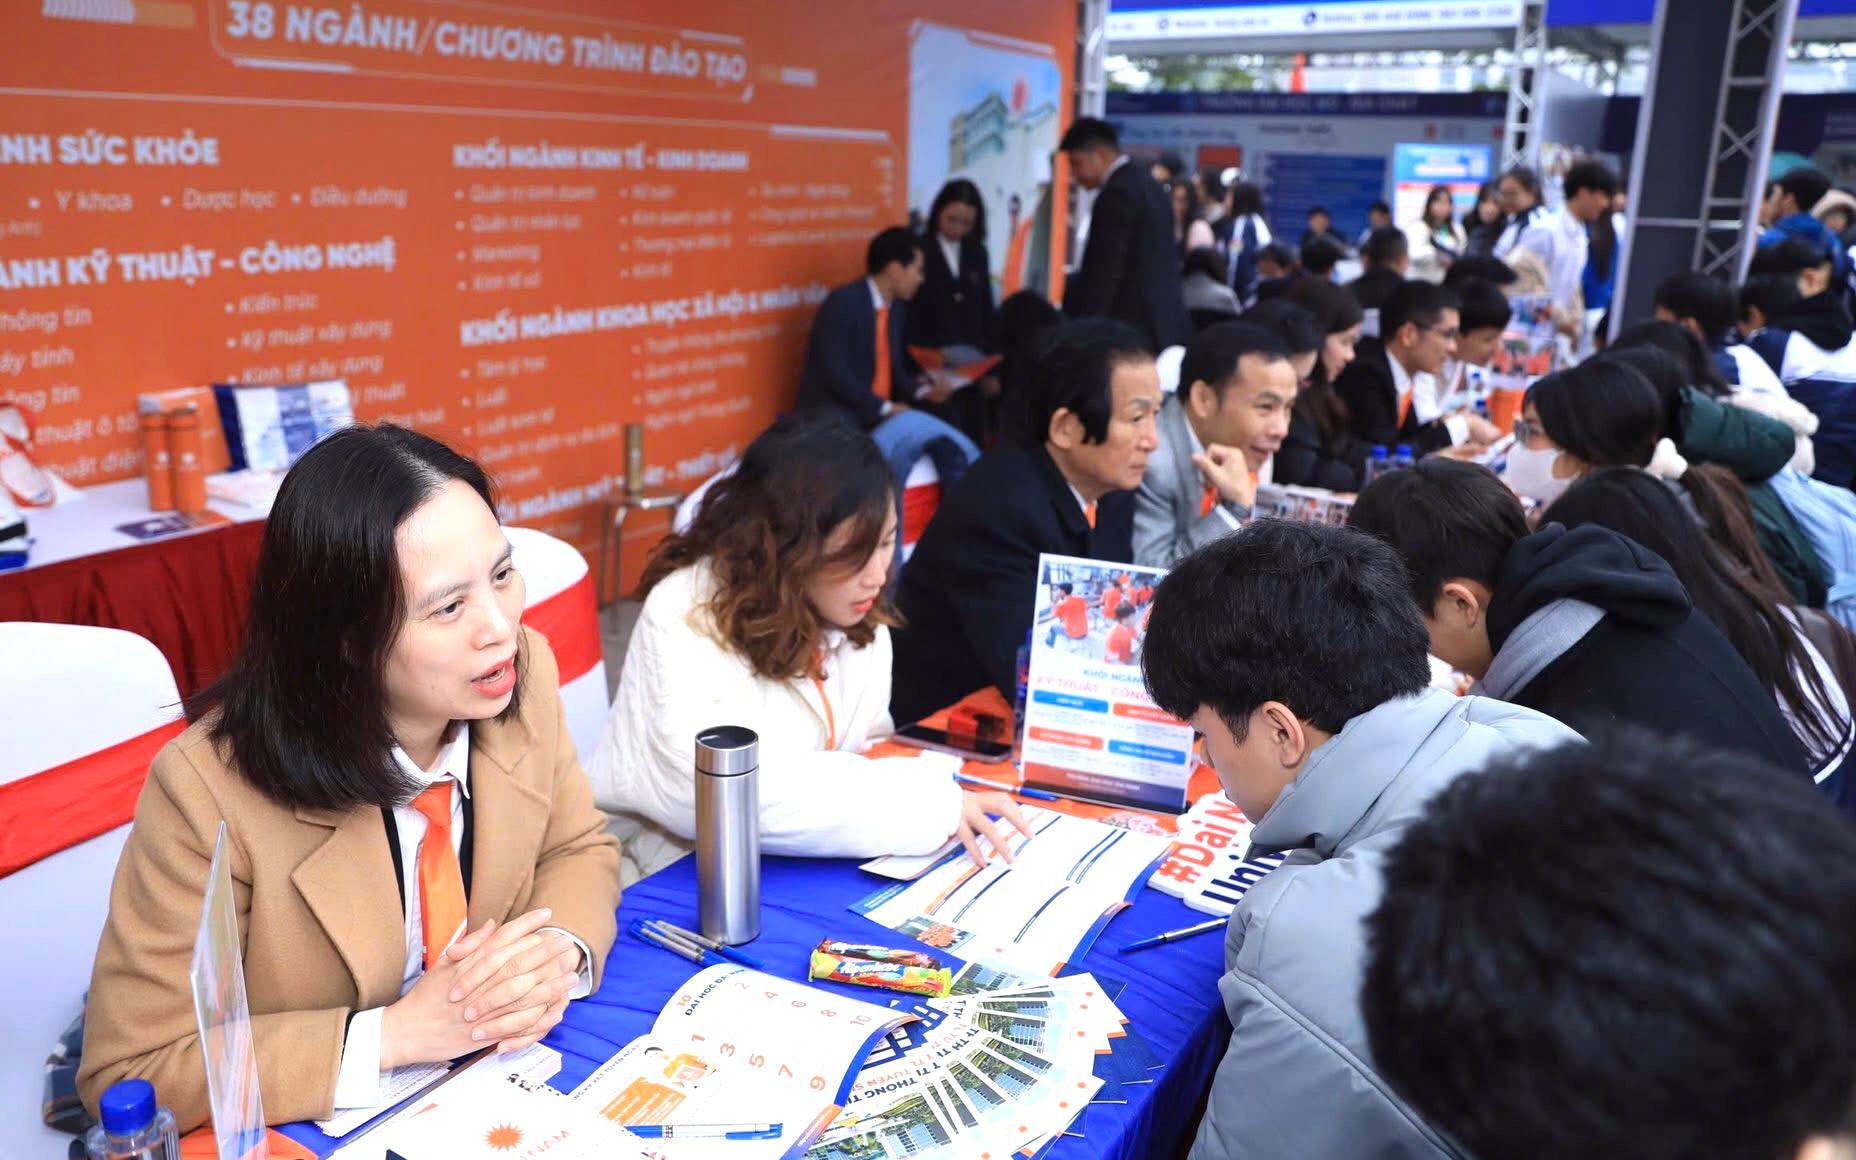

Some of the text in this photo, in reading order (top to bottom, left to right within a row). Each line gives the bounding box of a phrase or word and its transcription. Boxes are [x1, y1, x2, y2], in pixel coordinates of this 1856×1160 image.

[227, 1, 275, 40] 38
[571, 33, 646, 72] TRÌNH
[649, 40, 701, 78] ĐÀO
[704, 50, 747, 86] TẠO
[58, 128, 127, 165] SỨC
[134, 128, 220, 166] KHỎE
[453, 136, 506, 169] KHỐI
[509, 140, 578, 170] NGÀNH
[77, 190, 134, 212] khoa
[66, 247, 111, 284] KỸ
[118, 244, 215, 286] THUẬT
[239, 239, 323, 274] CÔNG
[327, 235, 395, 272] NGHỆ
[460, 307, 517, 347] KHỐI
[520, 304, 594, 340] NGÀNH
[651, 299, 691, 330] HỌC
[849, 1014, 872, 1026] 10
[719, 1043, 736, 1057] 3
[748, 1053, 765, 1068] 5
[778, 1063, 794, 1079] 7
[809, 1075, 827, 1092] 9
